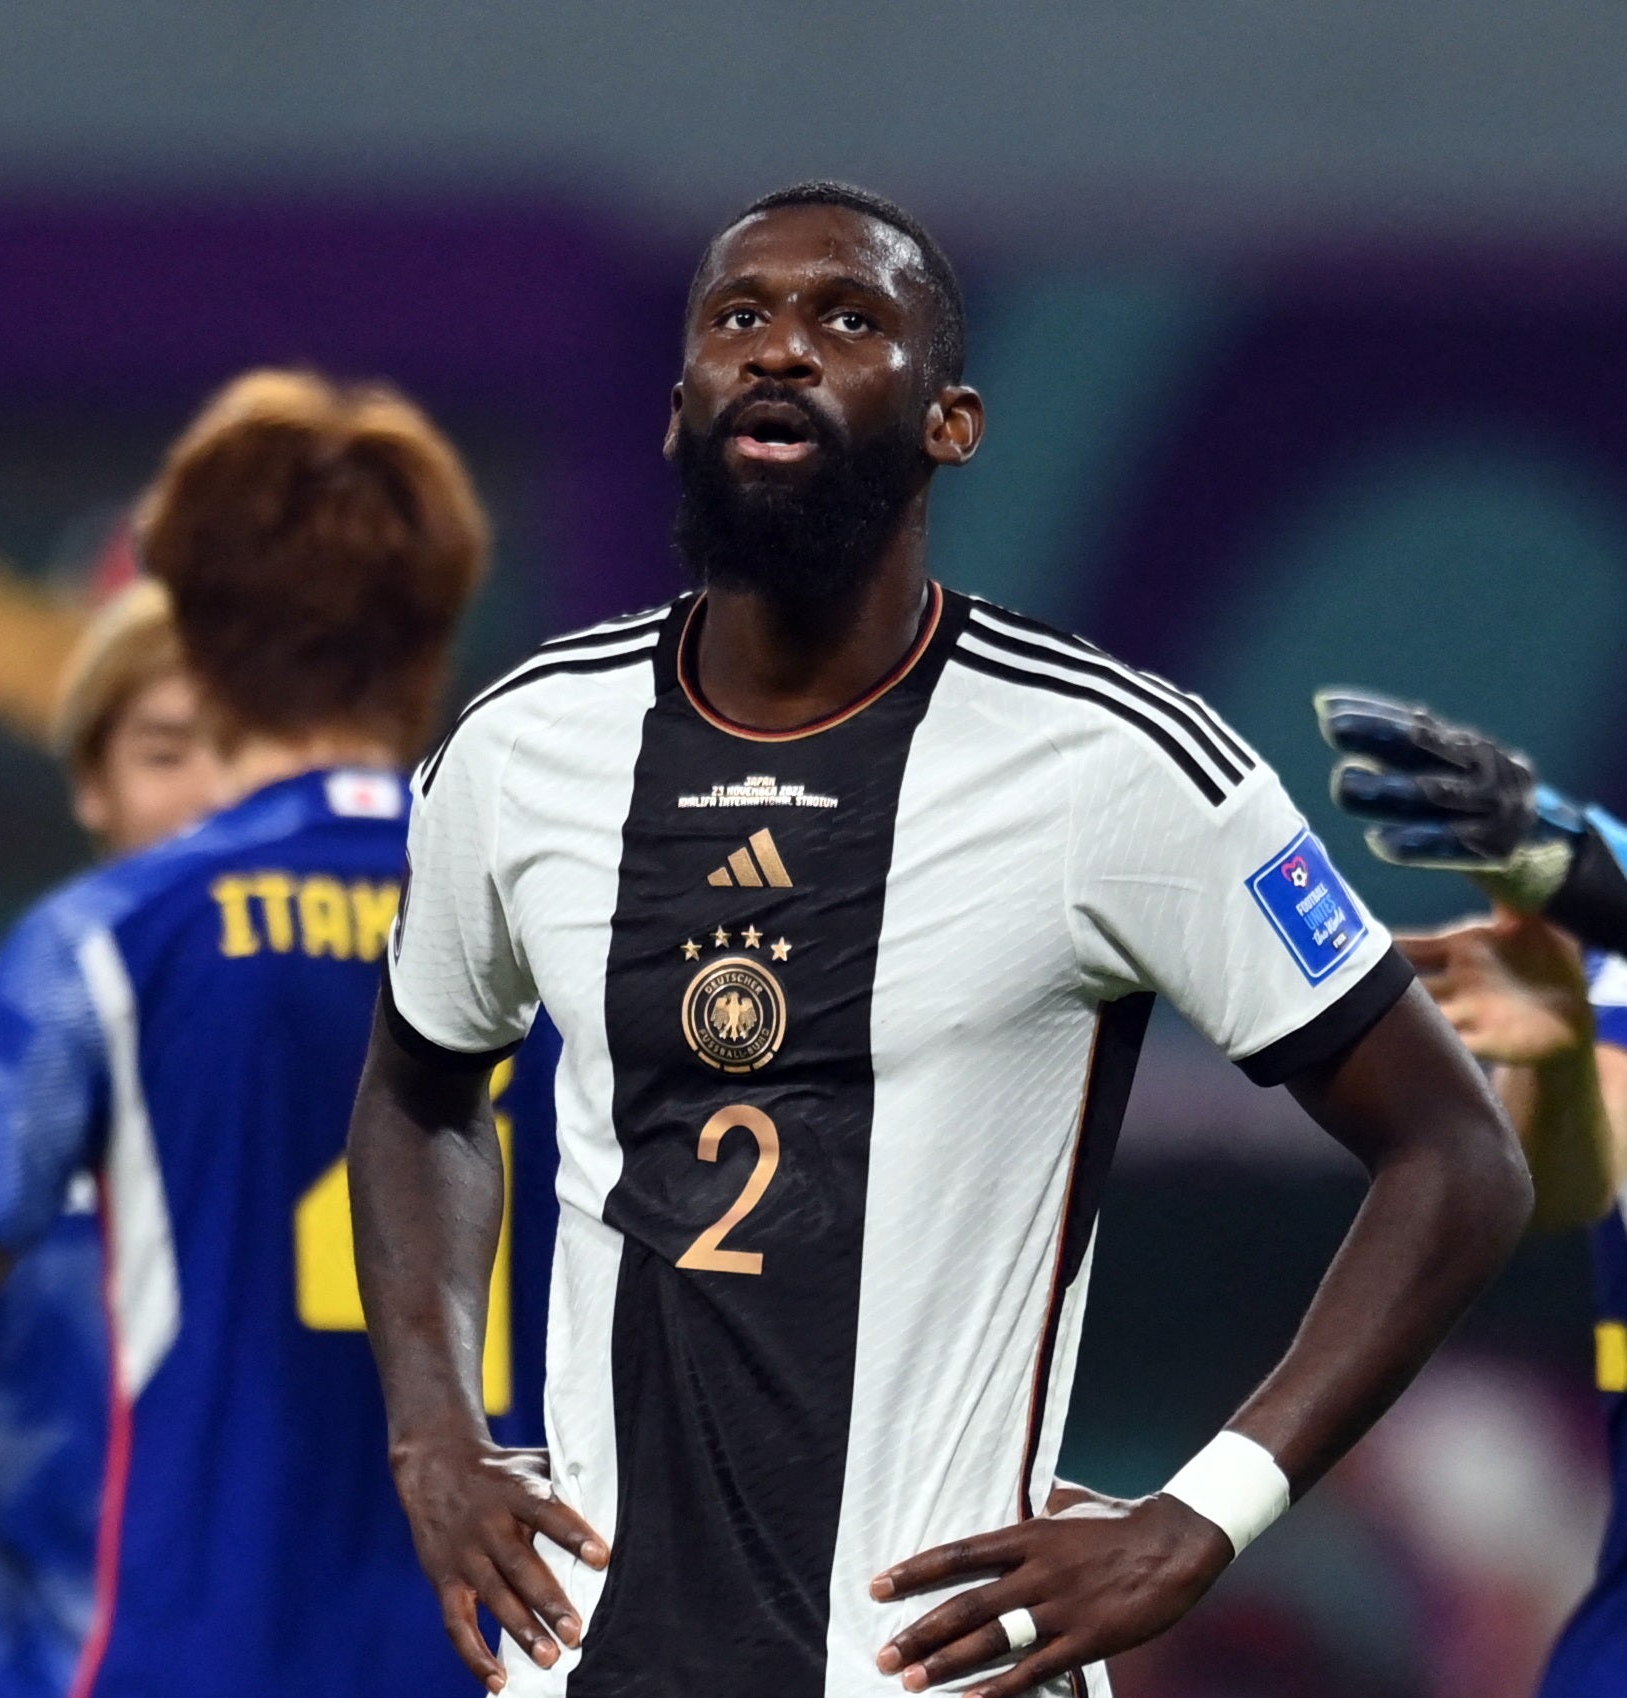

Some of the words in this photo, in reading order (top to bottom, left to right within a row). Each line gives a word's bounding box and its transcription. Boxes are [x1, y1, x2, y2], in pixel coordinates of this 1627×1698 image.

[712, 785, 724, 797] 23
[726, 785, 778, 797] NOVEMBER
[779, 785, 804, 797] 2022
[744, 776, 776, 787] JAPAN
[719, 795, 793, 807] INTERNATIONAL
[795, 795, 839, 808] STADIUM
[1295, 882, 1329, 917] FOOTBALL
[1303, 894, 1336, 931] UNITES
[704, 973, 764, 995] DEUTSCHER
[675, 1104, 780, 1275] 2
